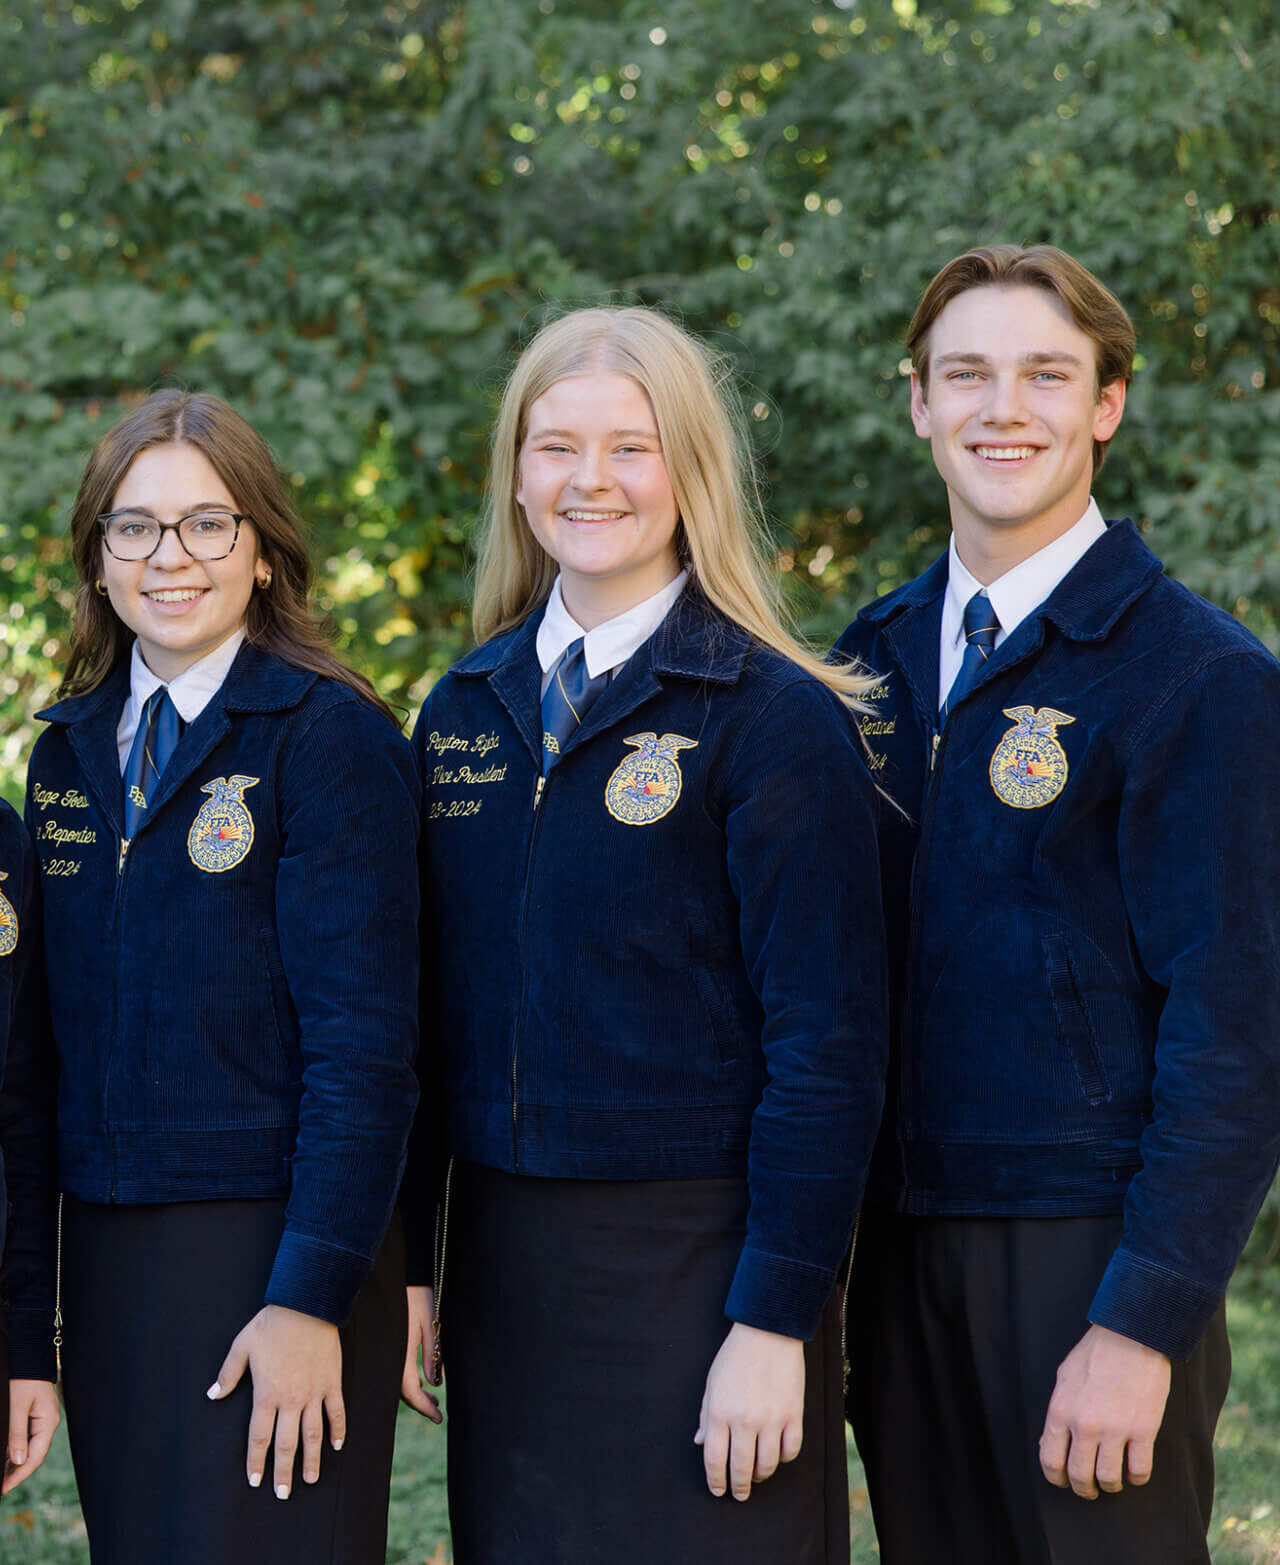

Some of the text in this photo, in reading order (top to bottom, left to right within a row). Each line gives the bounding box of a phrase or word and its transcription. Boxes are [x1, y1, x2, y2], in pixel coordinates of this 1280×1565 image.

[426, 731, 469, 756] Payton
[1015, 750, 1041, 762] FFA
[634, 771, 660, 783] FFA
[210, 816, 231, 828] FFA
